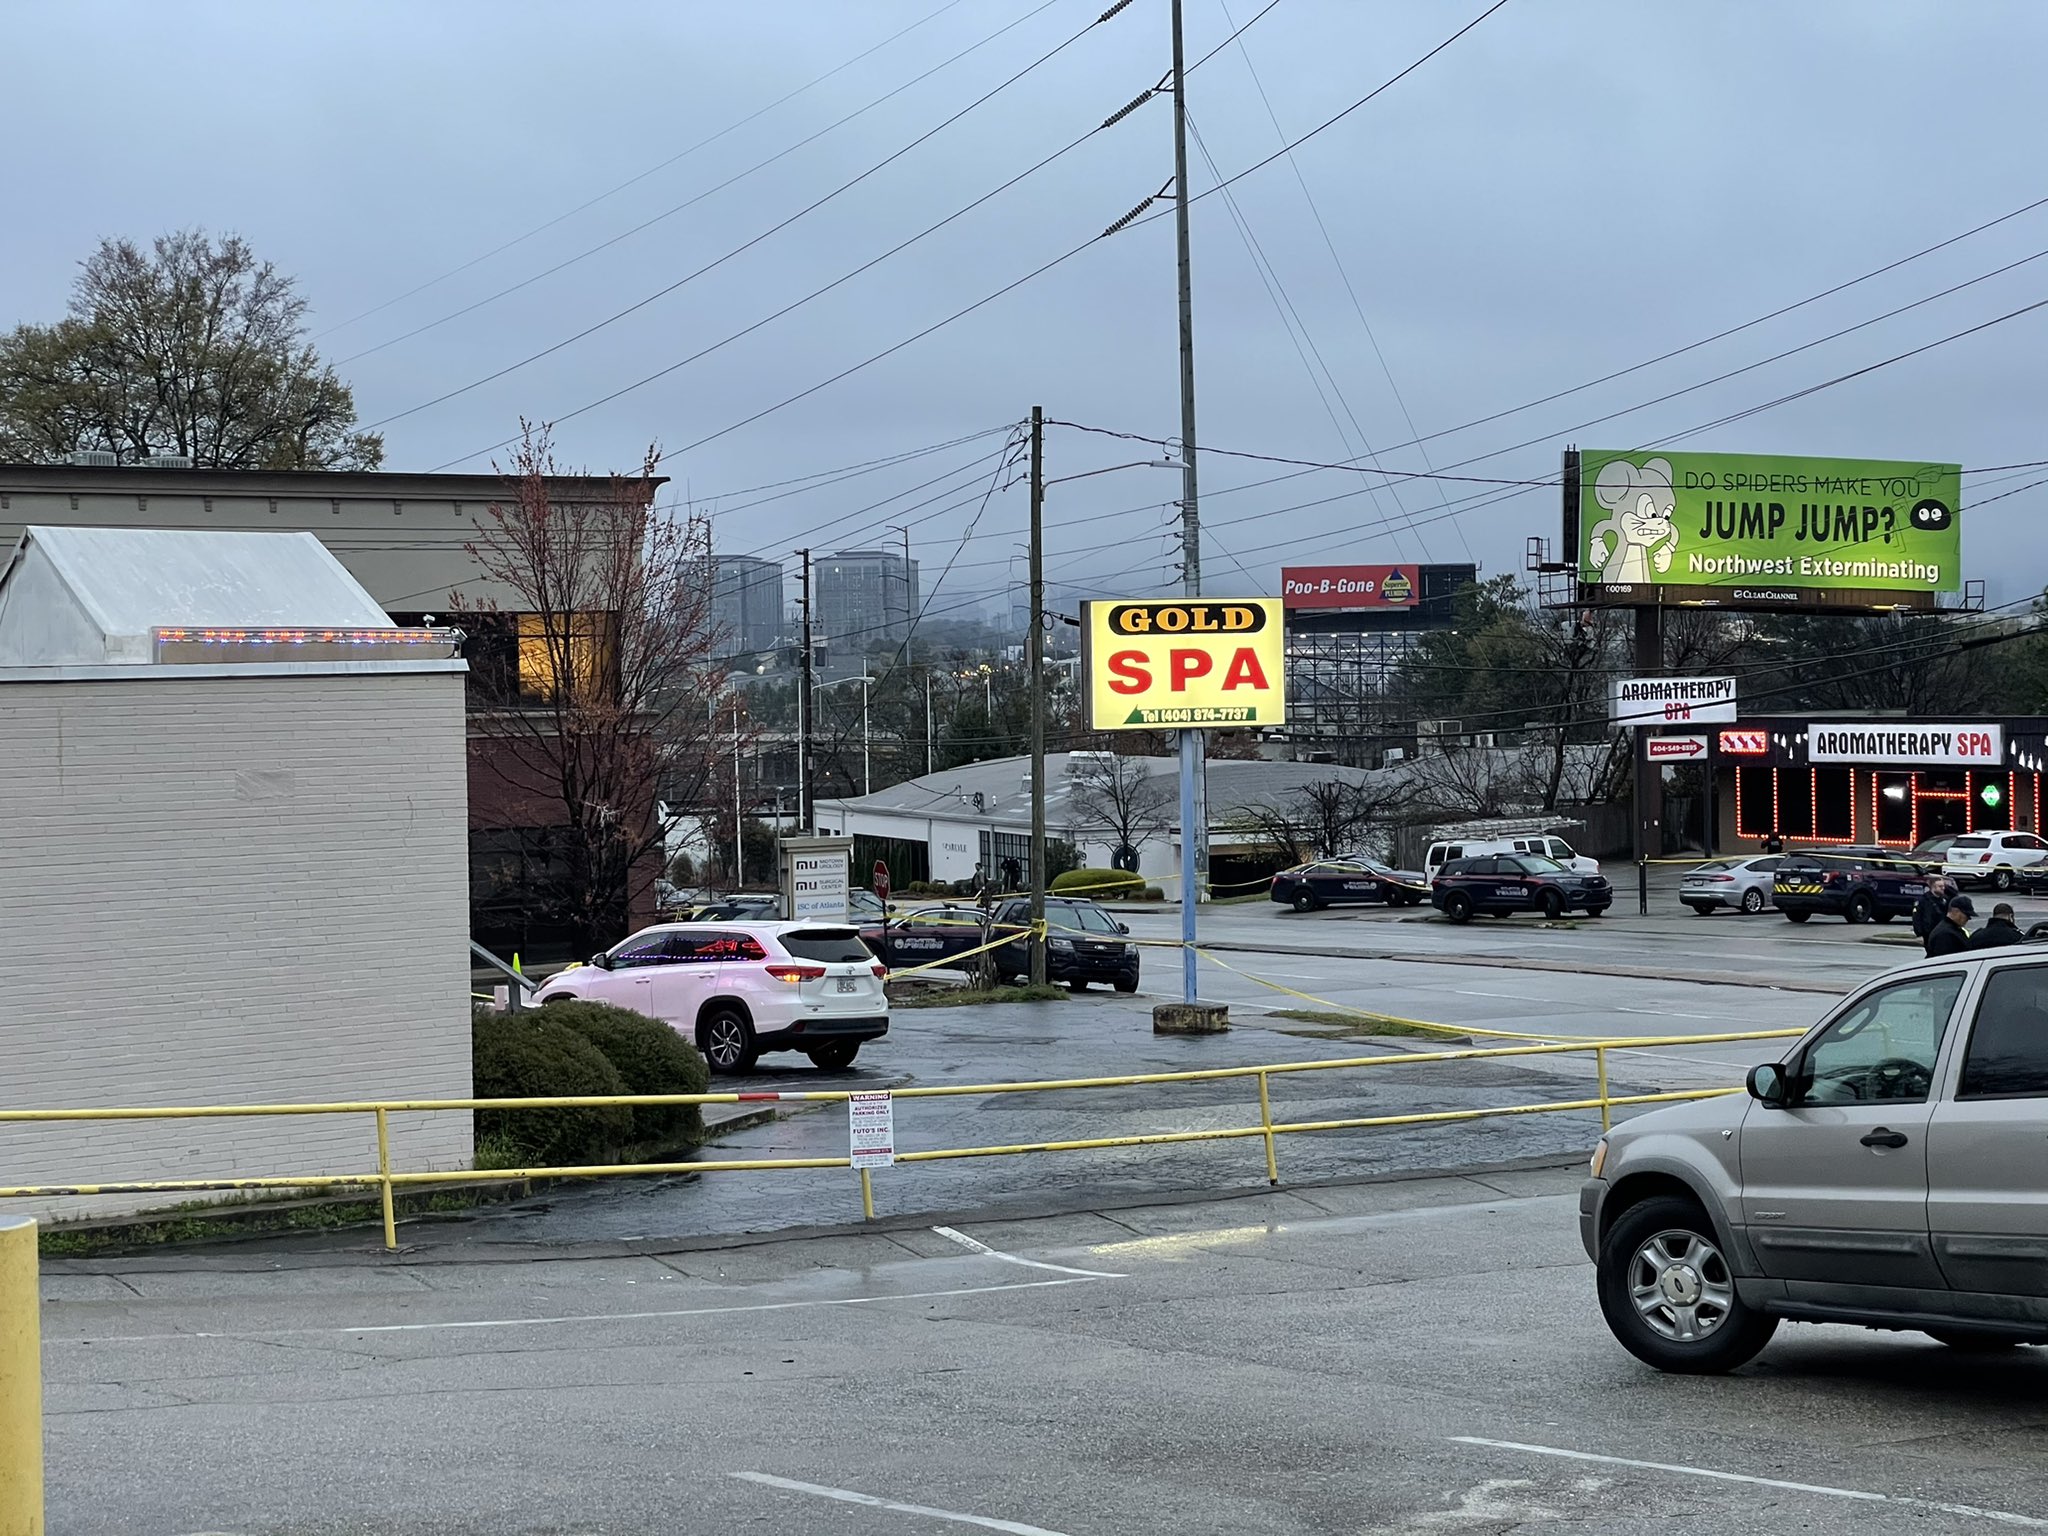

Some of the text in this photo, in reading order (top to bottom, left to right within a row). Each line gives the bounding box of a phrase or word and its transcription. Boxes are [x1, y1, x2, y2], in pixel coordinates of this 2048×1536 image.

[1685, 471, 1920, 498] DO SPIDERS MAKE YOU
[1699, 501, 1895, 544] JUMP JUMP?
[1688, 552, 1941, 584] Northwest Exterminating
[1285, 578, 1375, 595] Poo-B-Gone
[1119, 607, 1254, 632] GOLD
[1108, 647, 1270, 695] SPA
[1622, 681, 1732, 701] AROMATHERAPY
[1141, 707, 1249, 723] Tel (404) 874-7737
[1664, 702, 1691, 721] SPA
[1817, 732, 1993, 756] AROMATHERAPY SPA
[811, 902, 818, 910] of
[820, 901, 845, 909] Atlanta
